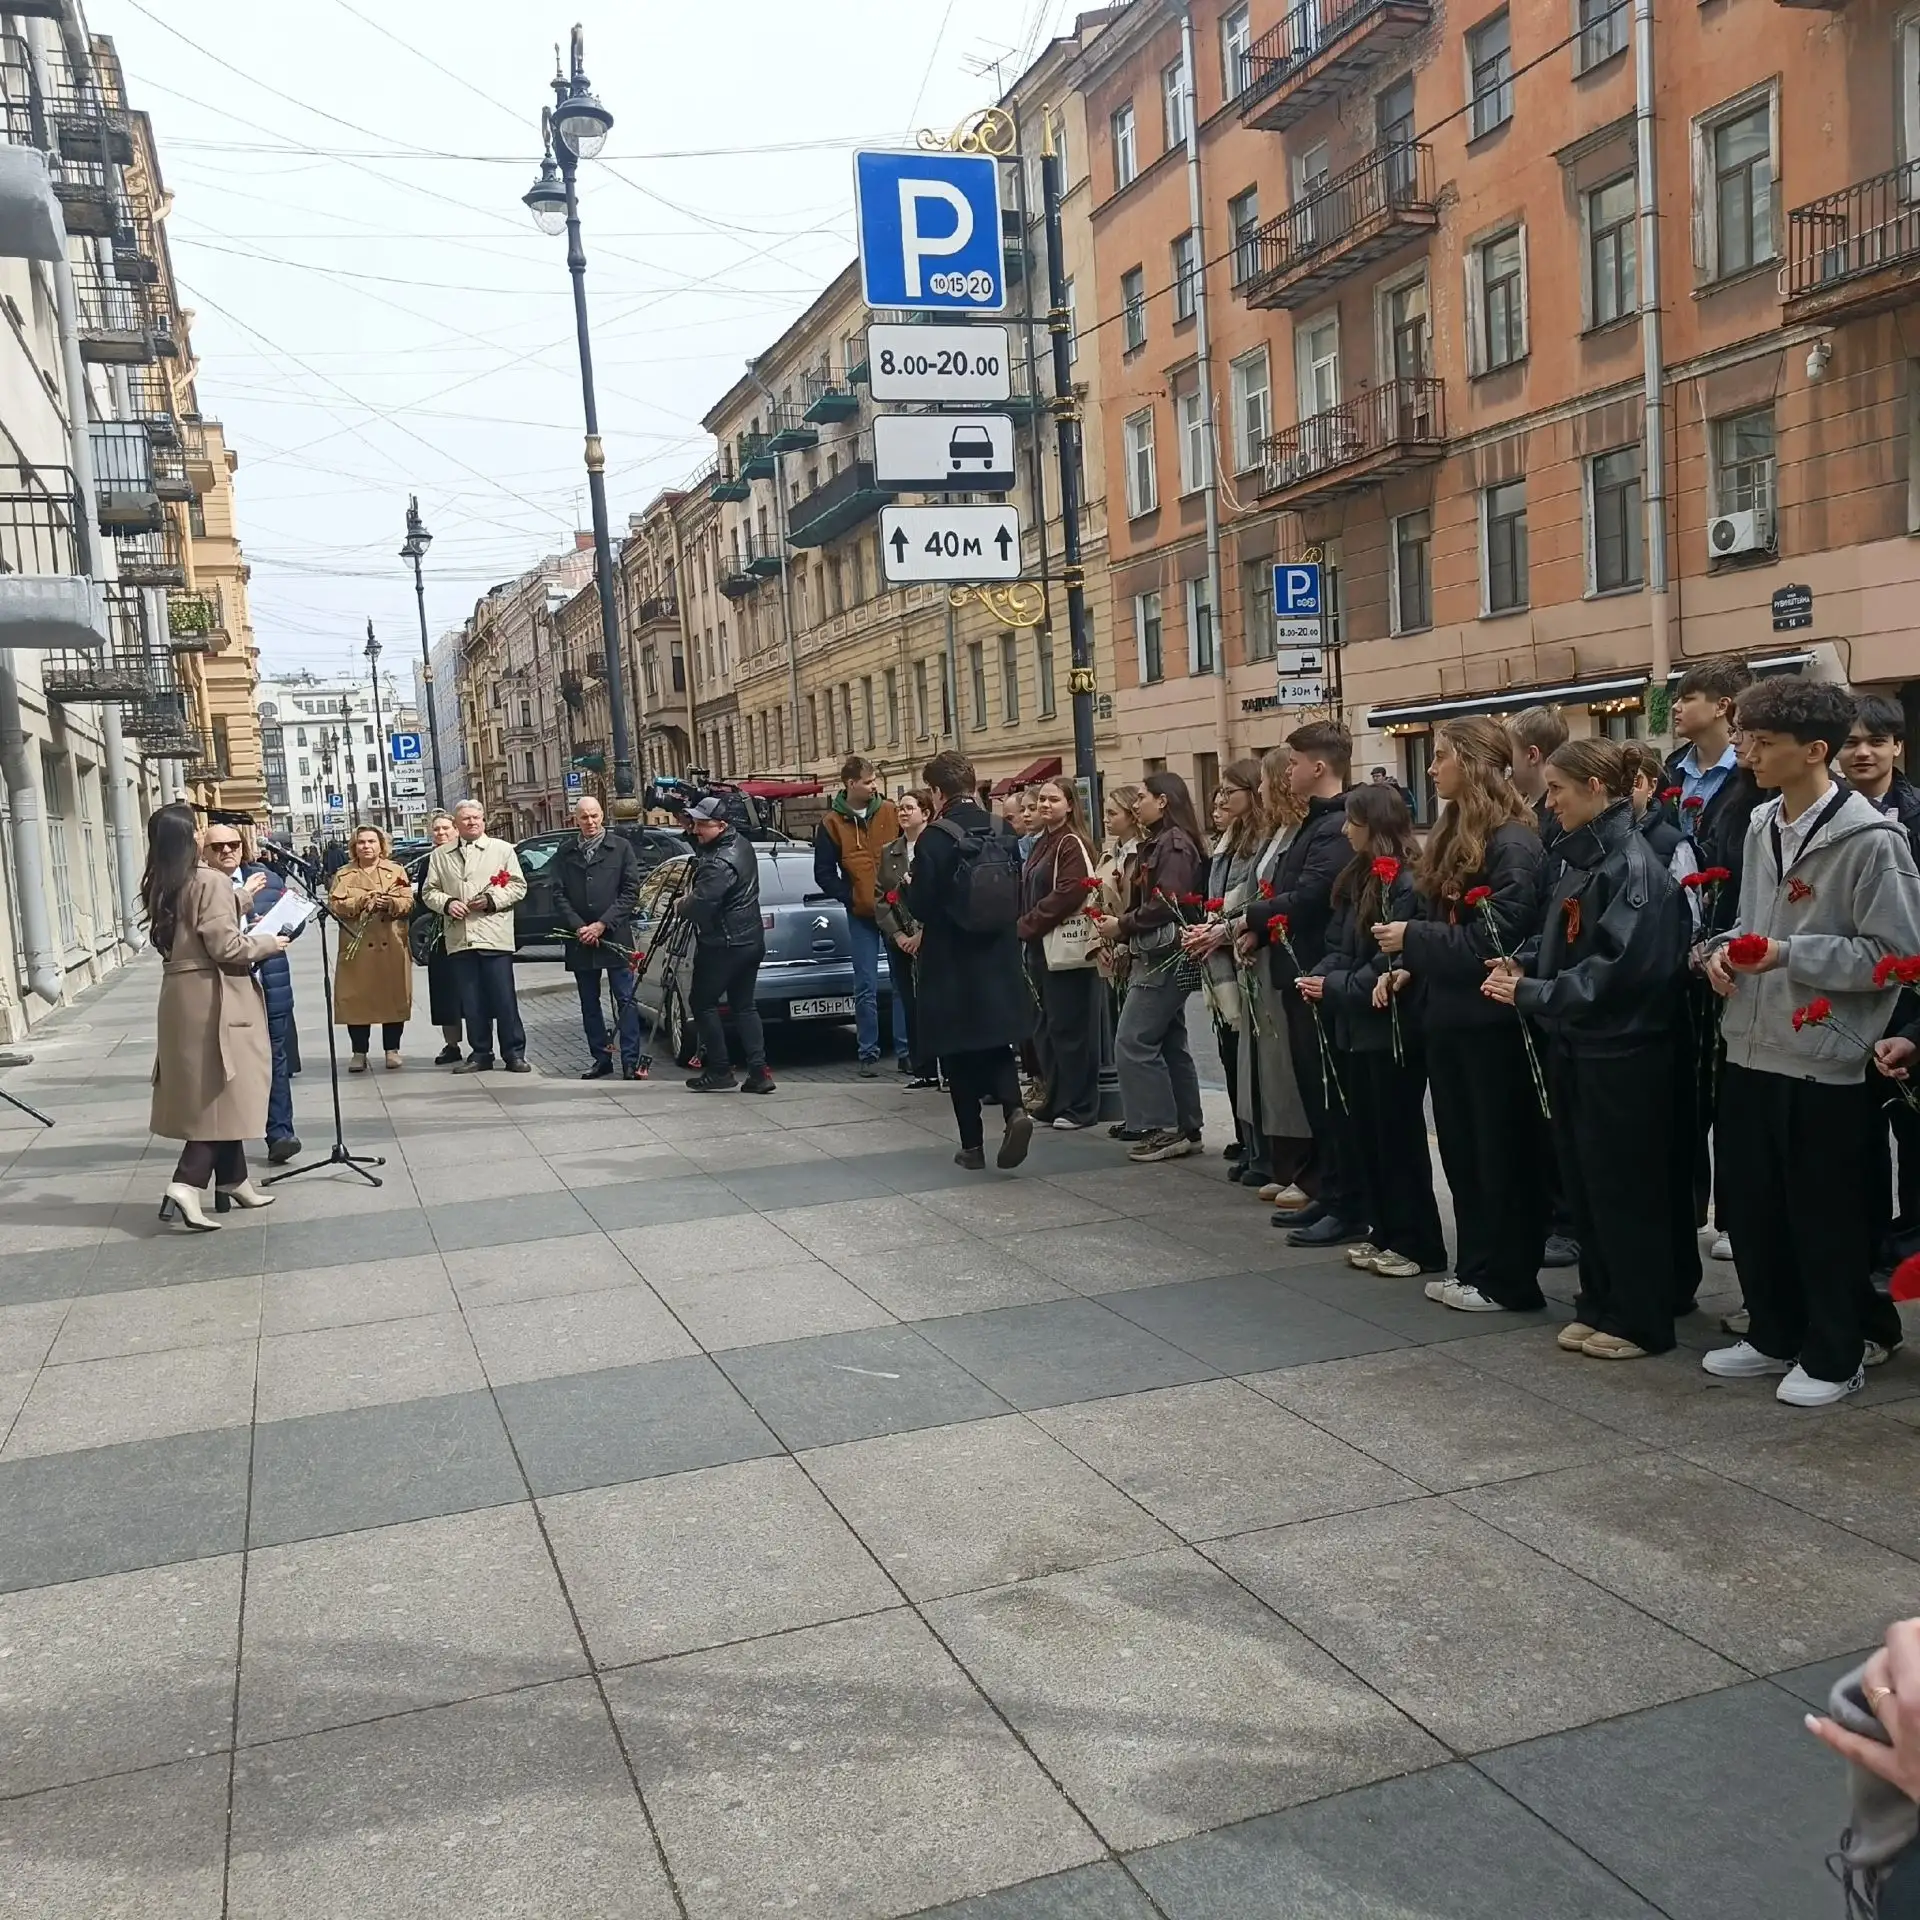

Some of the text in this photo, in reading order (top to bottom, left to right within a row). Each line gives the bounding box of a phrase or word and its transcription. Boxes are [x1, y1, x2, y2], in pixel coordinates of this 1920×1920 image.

[898, 178, 974, 297] P
[933, 276, 992, 295] 10 15 20
[880, 350, 999, 377] 8.00-20.00
[1287, 570, 1311, 609] P
[399, 736, 416, 758] P
[569, 773, 579, 785] P
[332, 795, 342, 806] P
